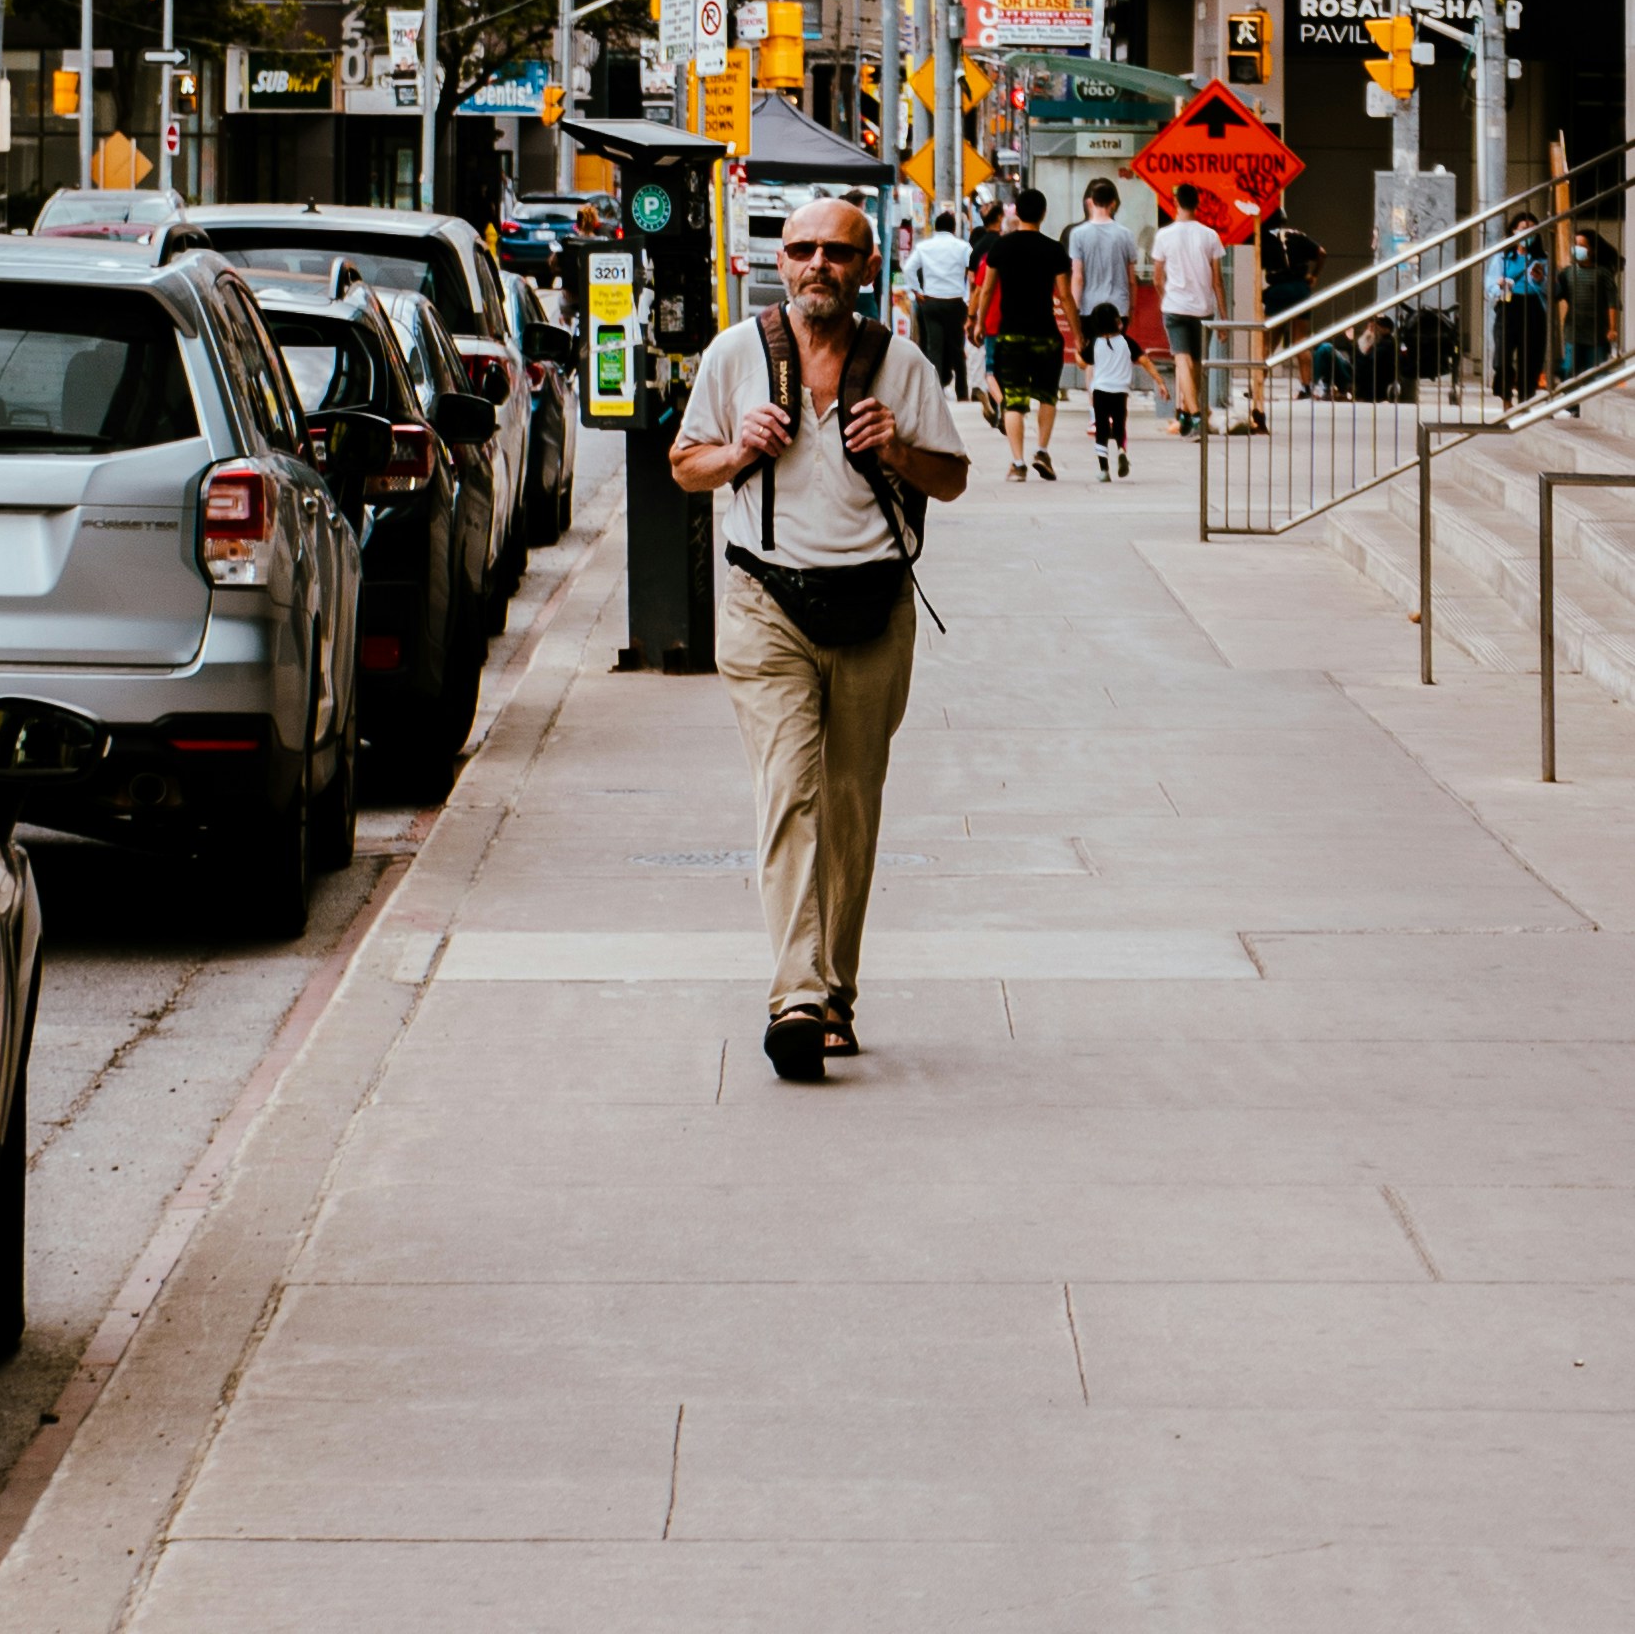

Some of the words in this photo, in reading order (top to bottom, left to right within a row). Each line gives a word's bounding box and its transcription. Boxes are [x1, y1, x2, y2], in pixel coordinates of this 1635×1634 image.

[1429, 0, 1523, 19] SHAP
[1300, 24, 1377, 44] PAVIL
[704, 74, 738, 84] LOSURE
[1083, 86, 1116, 97] IOLO
[705, 105, 733, 116] SLOW
[1089, 139, 1122, 149] astral
[1146, 153, 1286, 174] CONSTRUCTION
[644, 196, 660, 216] P
[595, 267, 626, 280] 3201
[779, 360, 789, 406] DAKINE
